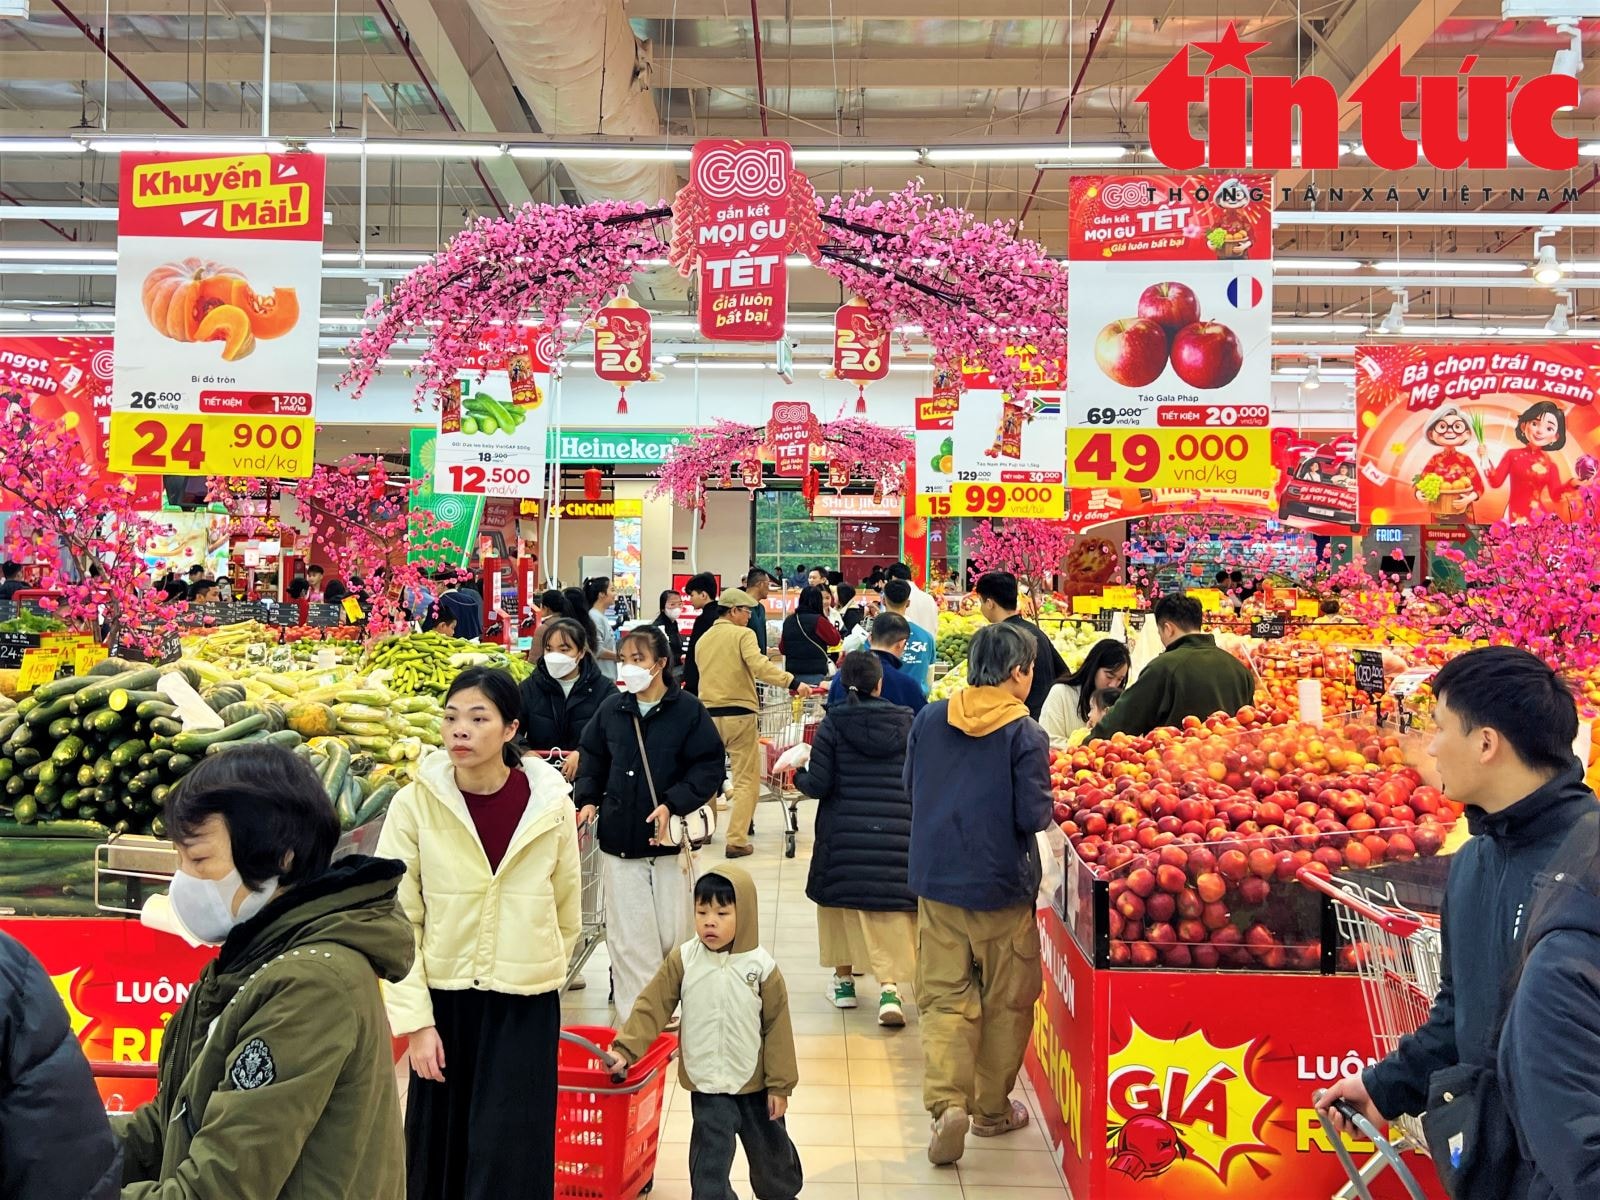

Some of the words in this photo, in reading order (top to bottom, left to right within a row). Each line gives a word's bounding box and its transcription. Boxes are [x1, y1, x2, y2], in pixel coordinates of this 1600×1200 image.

[139, 162, 262, 197] Khuyến
[697, 149, 787, 198] GO!
[1102, 182, 1150, 209] GO!
[231, 186, 303, 227] Mãi!
[716, 204, 743, 221] gắn
[748, 203, 770, 217] kết
[1137, 201, 1191, 233] TẾT
[699, 223, 745, 247] MỌI
[750, 218, 787, 240] GU
[1084, 229, 1111, 243] MỌI
[1114, 226, 1135, 239] GU
[1128, 241, 1149, 251] luôn
[706, 244, 779, 289] TẾT
[712, 294, 737, 312] Giá
[740, 293, 773, 307] luôn
[716, 308, 741, 327] bất
[744, 309, 768, 325] bại
[0, 351, 49, 372] ngọt
[1401, 360, 1429, 386] Bà
[1433, 354, 1486, 376] chọn
[1491, 353, 1530, 371] trái
[1532, 359, 1584, 381] ngọt
[11, 370, 58, 392] xanh
[1409, 382, 1440, 407] Mẹ
[1444, 373, 1498, 395] chọn
[1501, 374, 1538, 390] rau
[1541, 379, 1594, 402] xanh
[130, 391, 182, 410] 26.600
[1156, 394, 1175, 402] Gala
[1177, 394, 1199, 404] Pháp
[775, 404, 808, 423] GO!
[1087, 407, 1142, 425] 69.000
[1116, 418, 1140, 426] vnd/kg
[1205, 406, 1267, 425] 20.000
[794, 431, 808, 439] GU
[778, 440, 805, 457] TẾT
[1074, 433, 1249, 483] 49.000
[233, 454, 298, 472] vnd/kg
[448, 465, 530, 493] 12.500
[1174, 464, 1237, 483] vnd/kg
[965, 485, 1052, 513] 99.000
[1376, 529, 1401, 542] FRICO
[1428, 531, 1450, 539] Sitting
[1108, 1062, 1237, 1140] GIÁ
